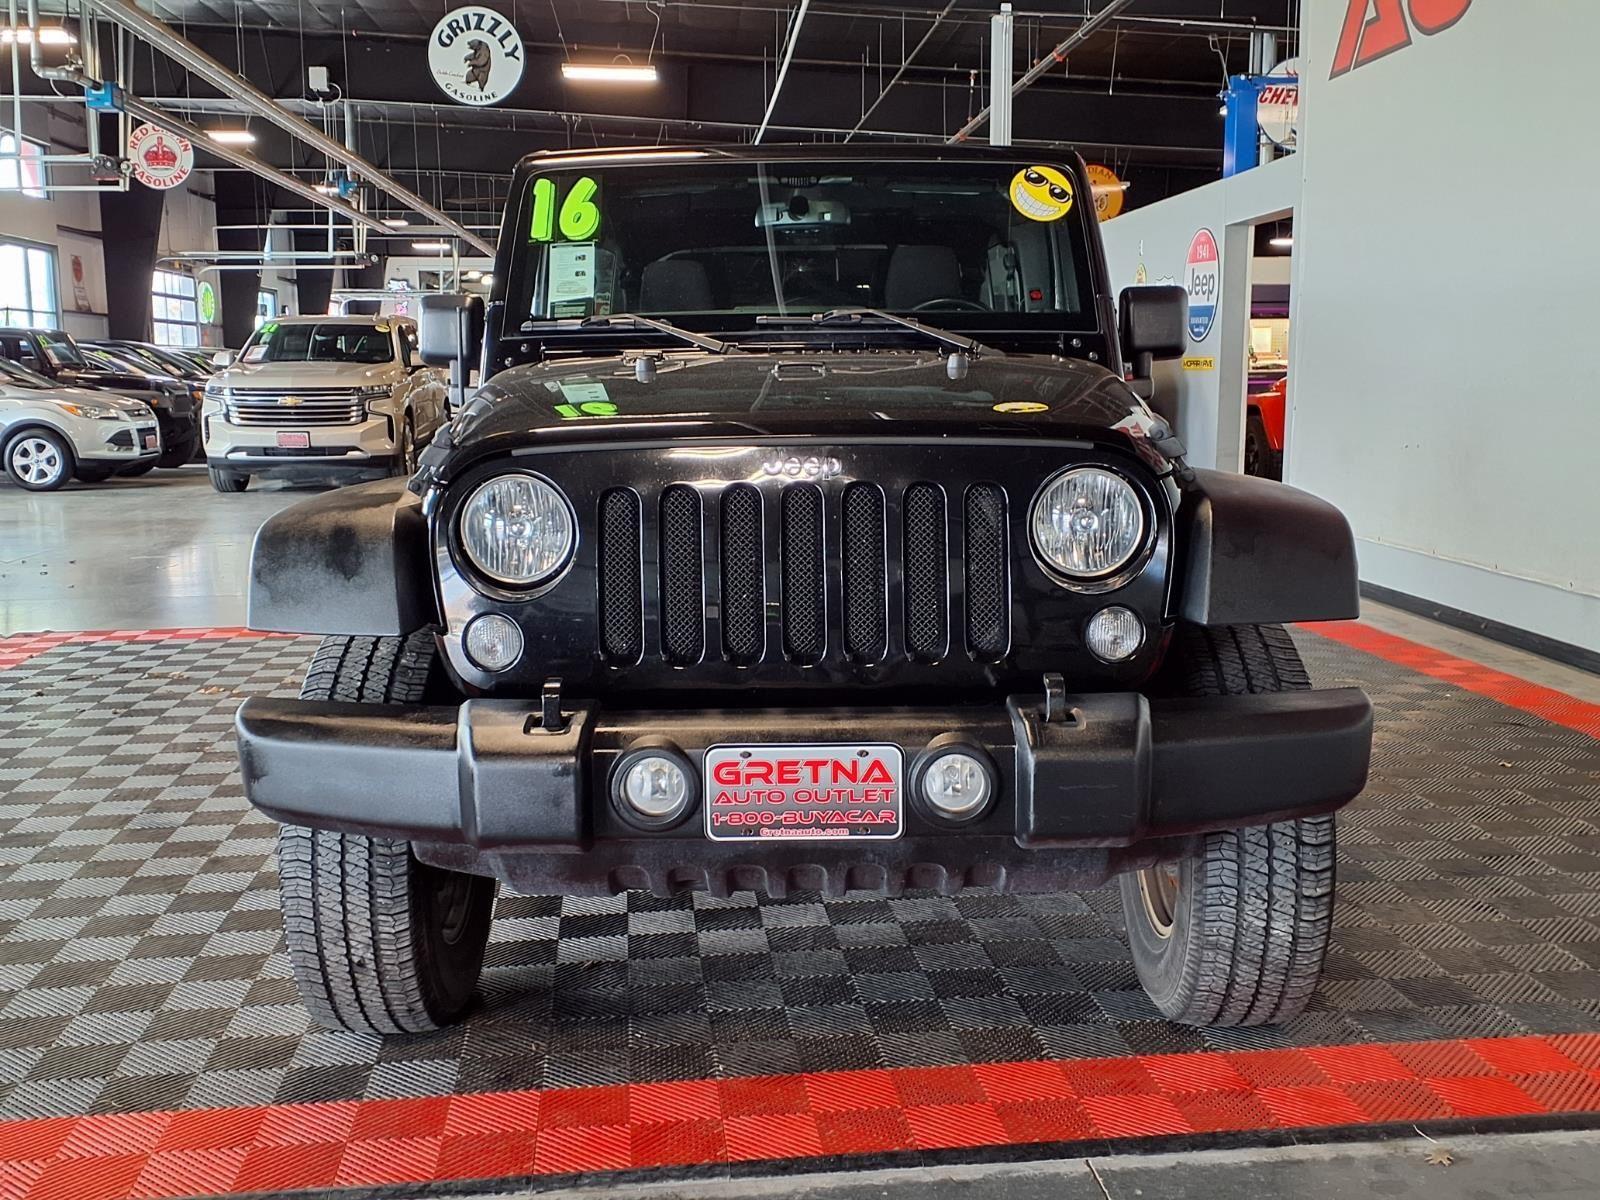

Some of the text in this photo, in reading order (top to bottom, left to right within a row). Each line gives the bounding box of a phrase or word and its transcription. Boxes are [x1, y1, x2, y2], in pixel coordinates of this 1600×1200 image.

[437, 13, 520, 62] GRIZZLY
[444, 82, 498, 102] GASOLINE
[129, 126, 149, 150] RED
[132, 162, 189, 187] GASOLINE
[530, 176, 600, 241] 16
[1187, 267, 1215, 302] Jeep
[762, 456, 842, 481] Jeep
[712, 758, 896, 786] GRETNA
[712, 788, 897, 806] AUTO OUTLET
[711, 810, 897, 826] 1-800-BUYACAR
